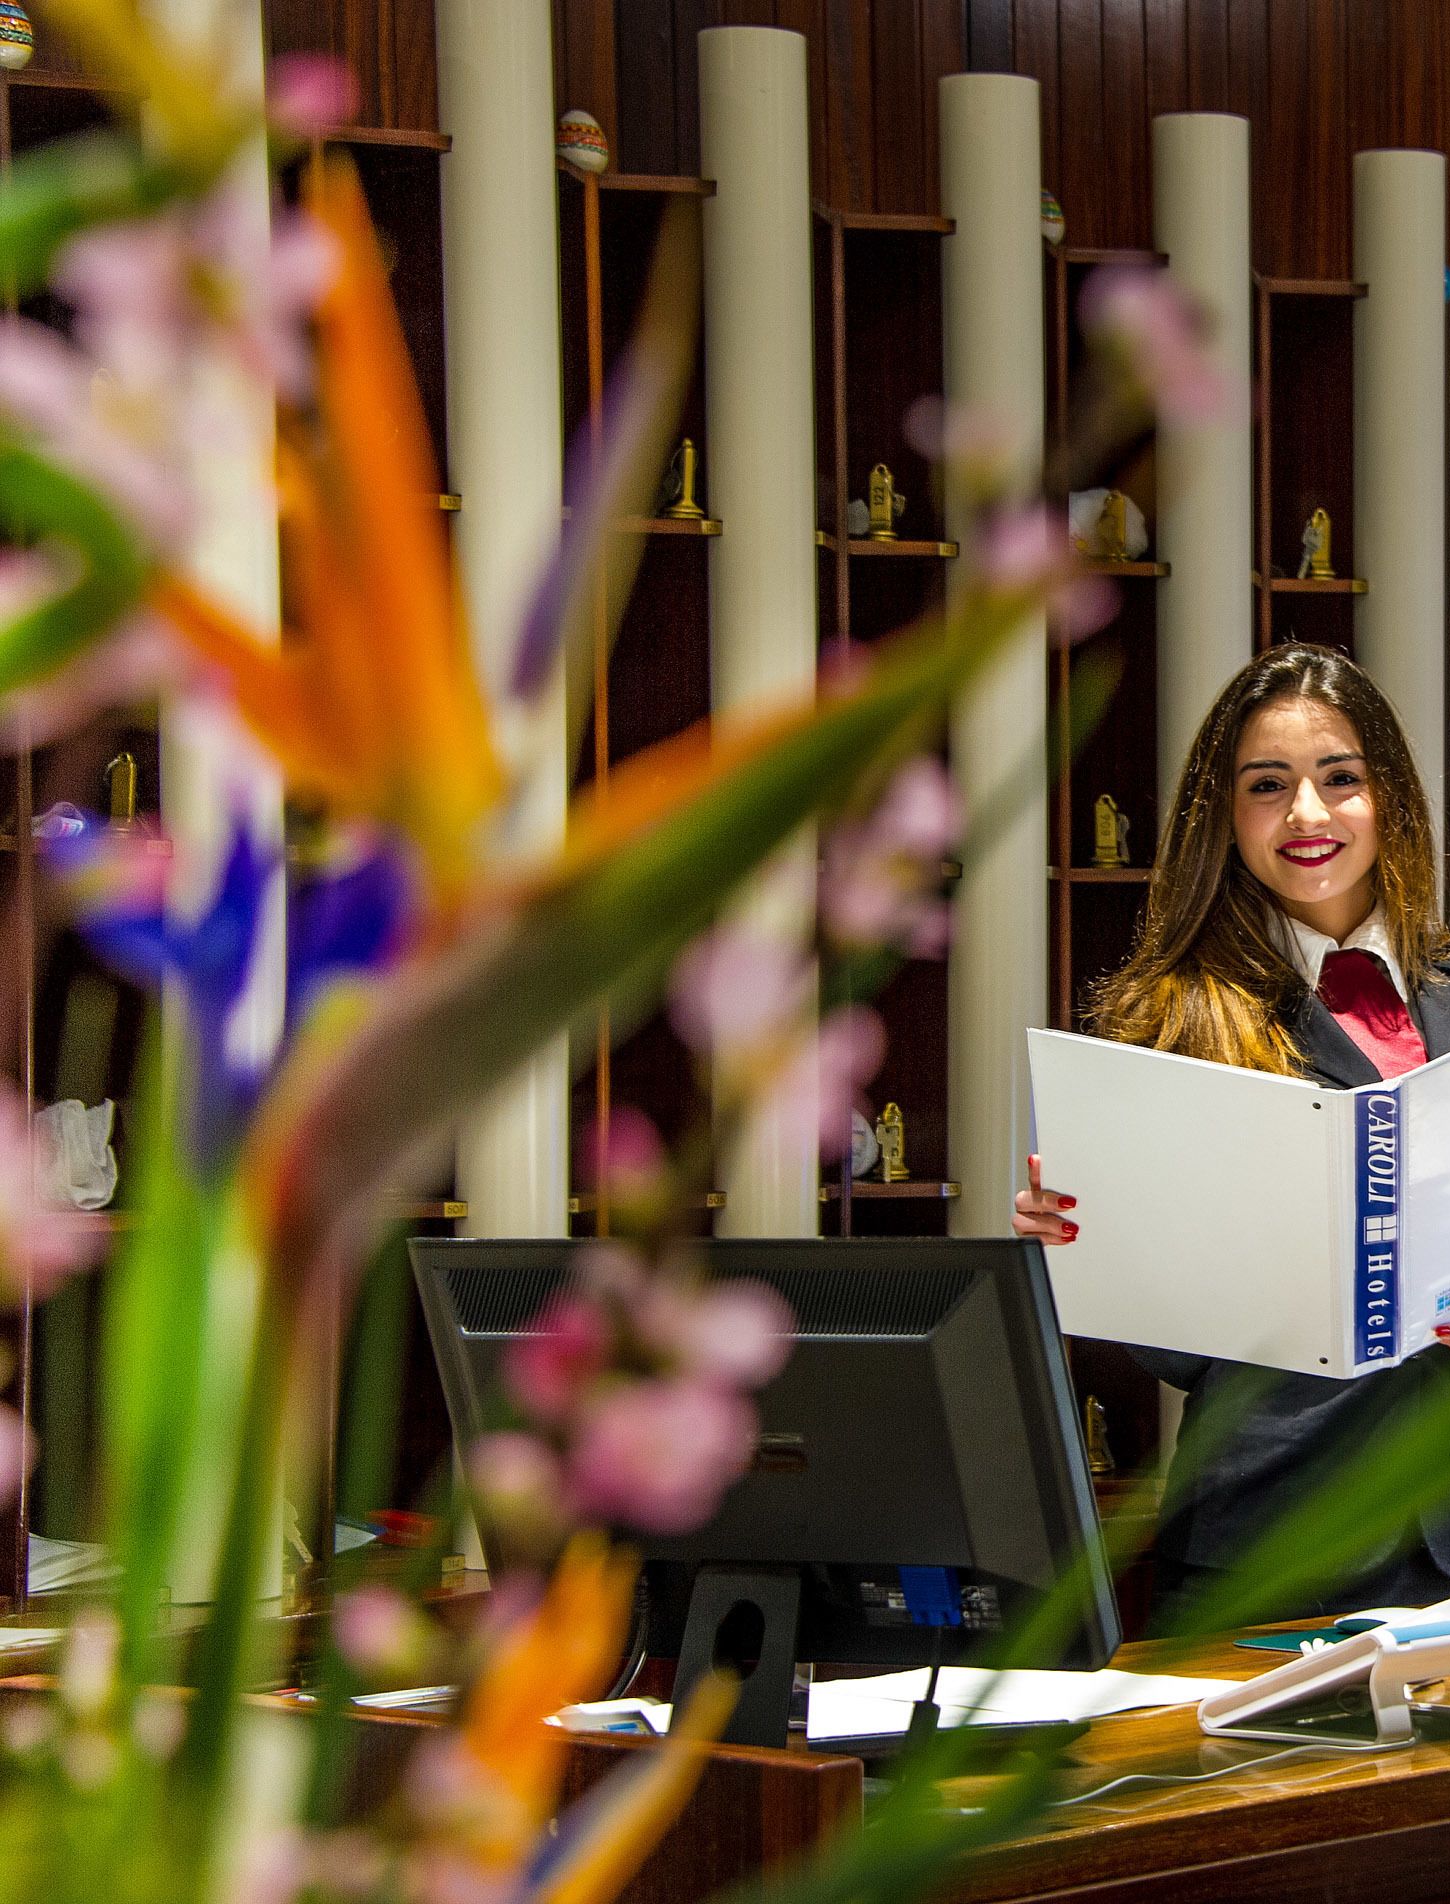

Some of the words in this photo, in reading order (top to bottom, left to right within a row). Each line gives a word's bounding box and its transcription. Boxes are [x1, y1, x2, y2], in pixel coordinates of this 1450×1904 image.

[873, 487, 885, 505] 122
[1367, 1094, 1397, 1203] CAROLI
[1367, 1252, 1393, 1357] Hotels
